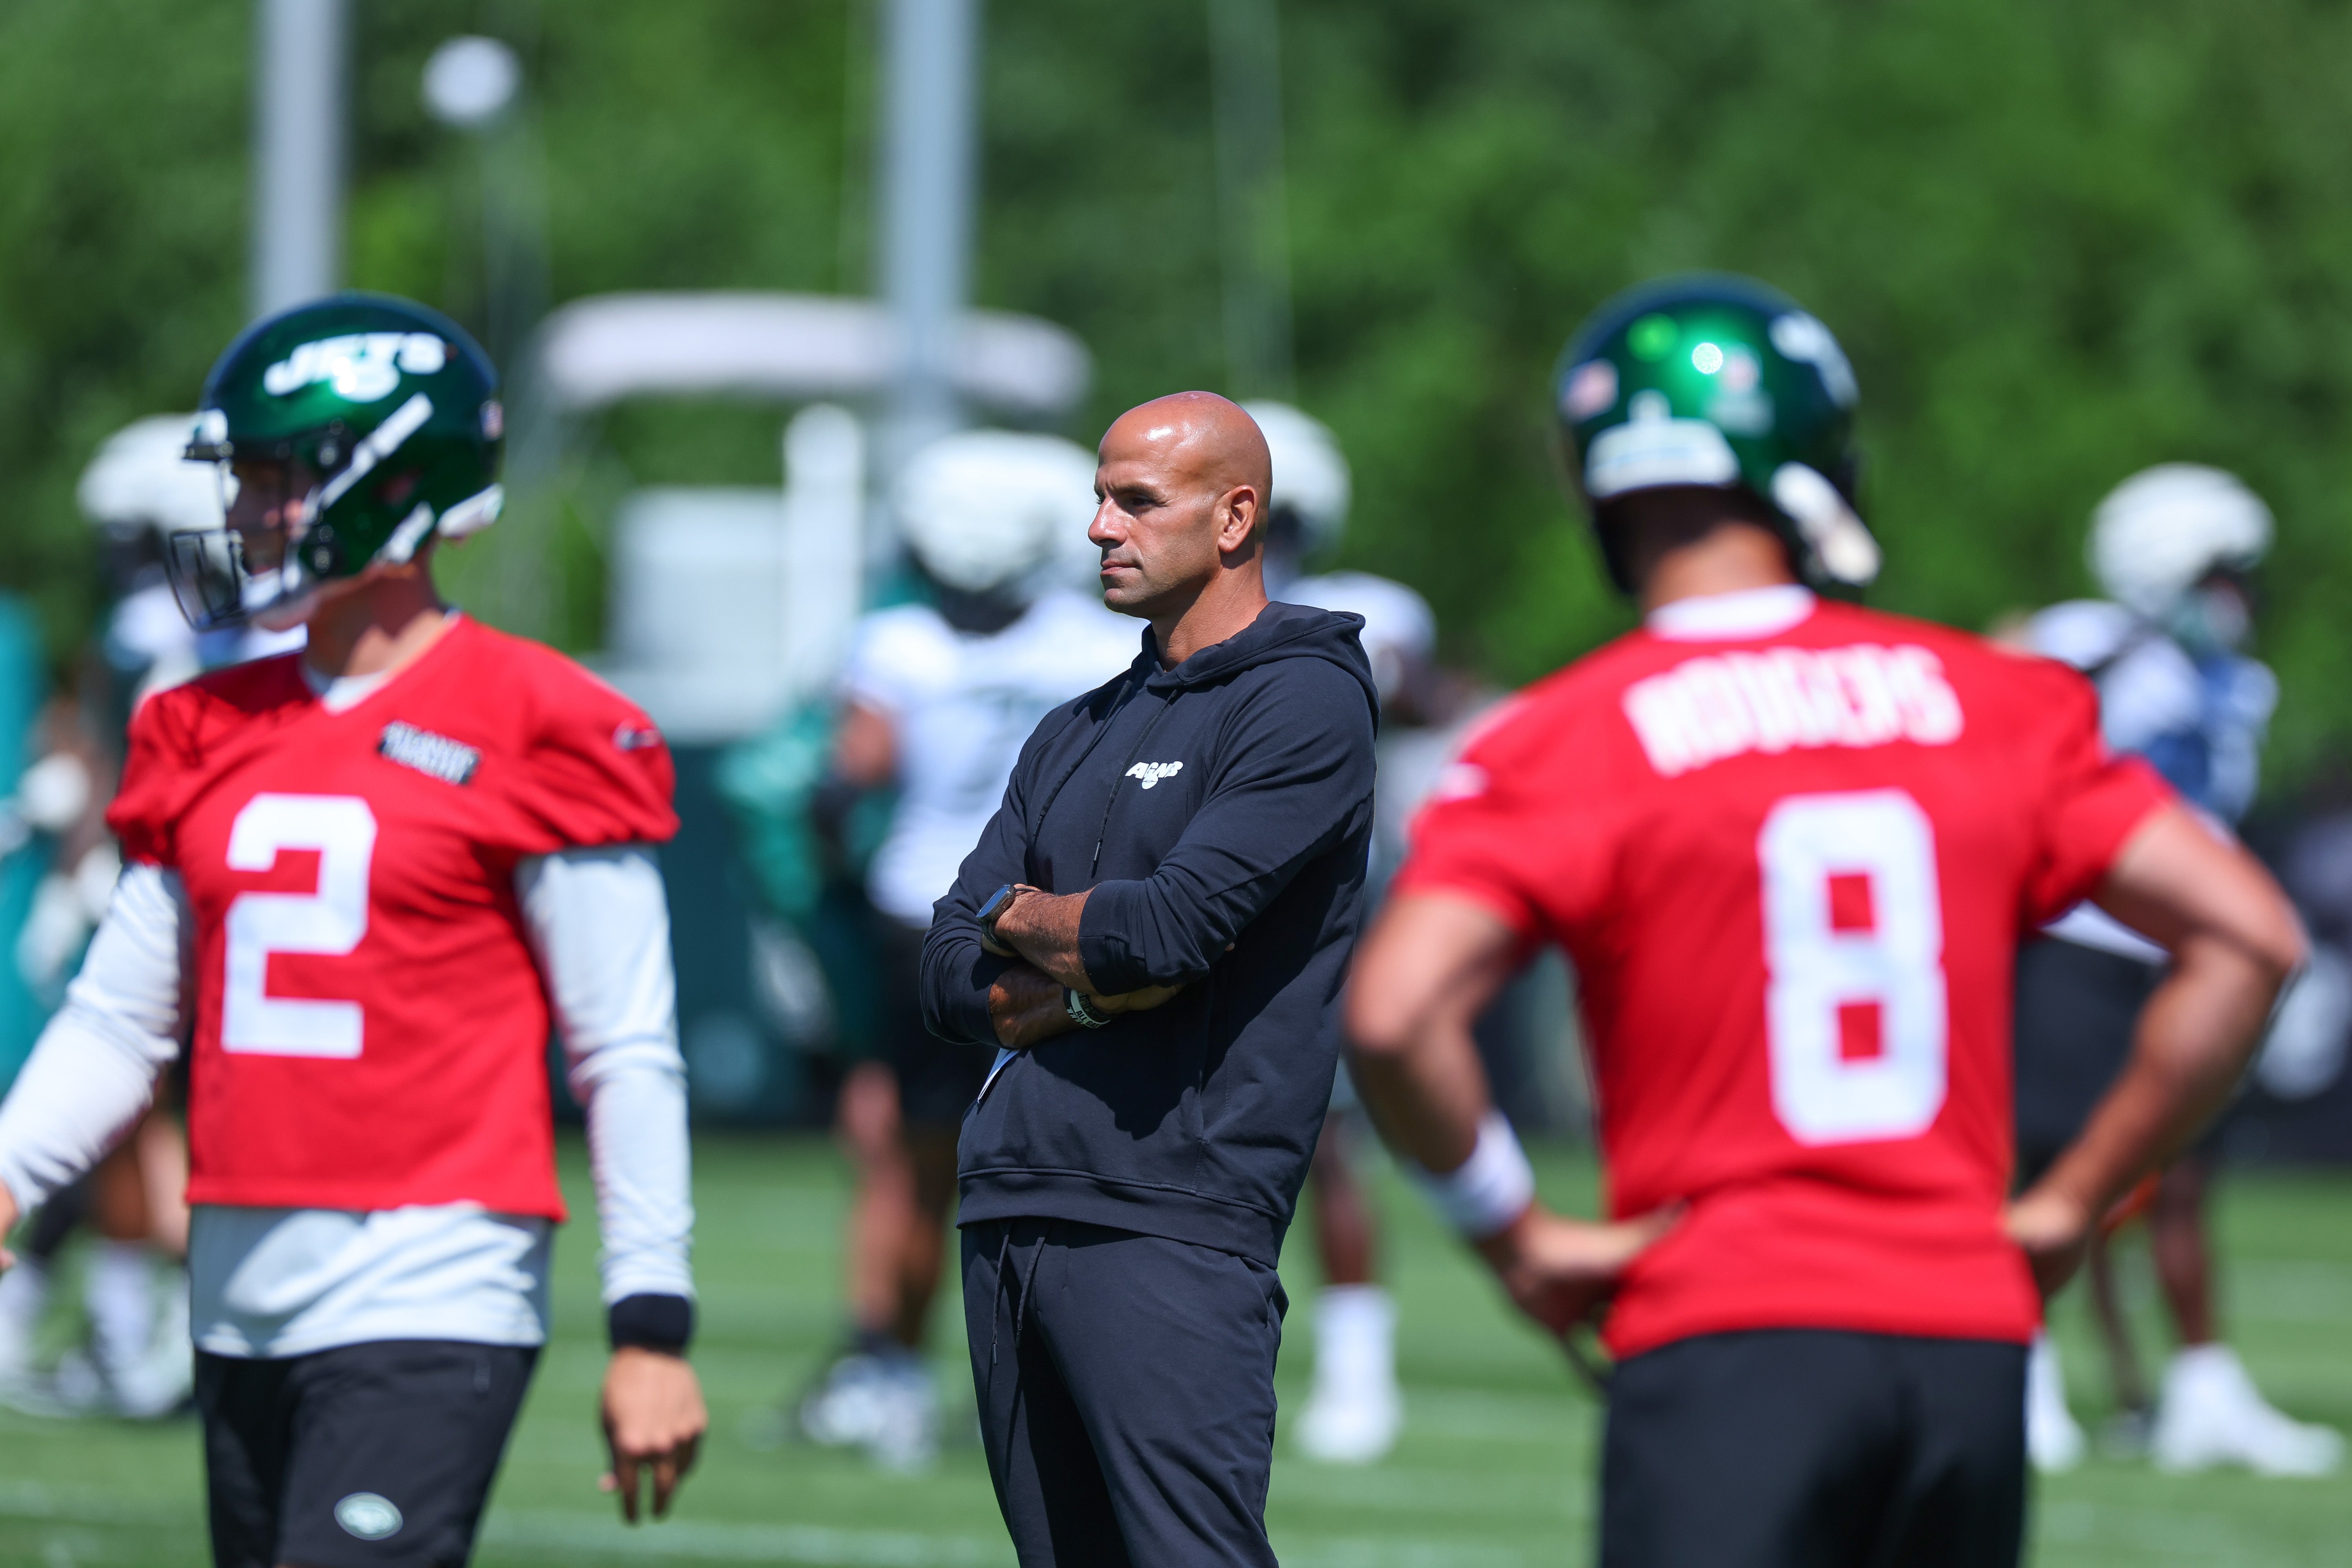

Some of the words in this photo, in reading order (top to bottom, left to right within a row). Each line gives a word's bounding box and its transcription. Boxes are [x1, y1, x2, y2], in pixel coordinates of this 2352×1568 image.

[221, 792, 379, 1059] 2
[1076, 1010, 1087, 1022] ALL
[1757, 787, 1950, 1148] 8
